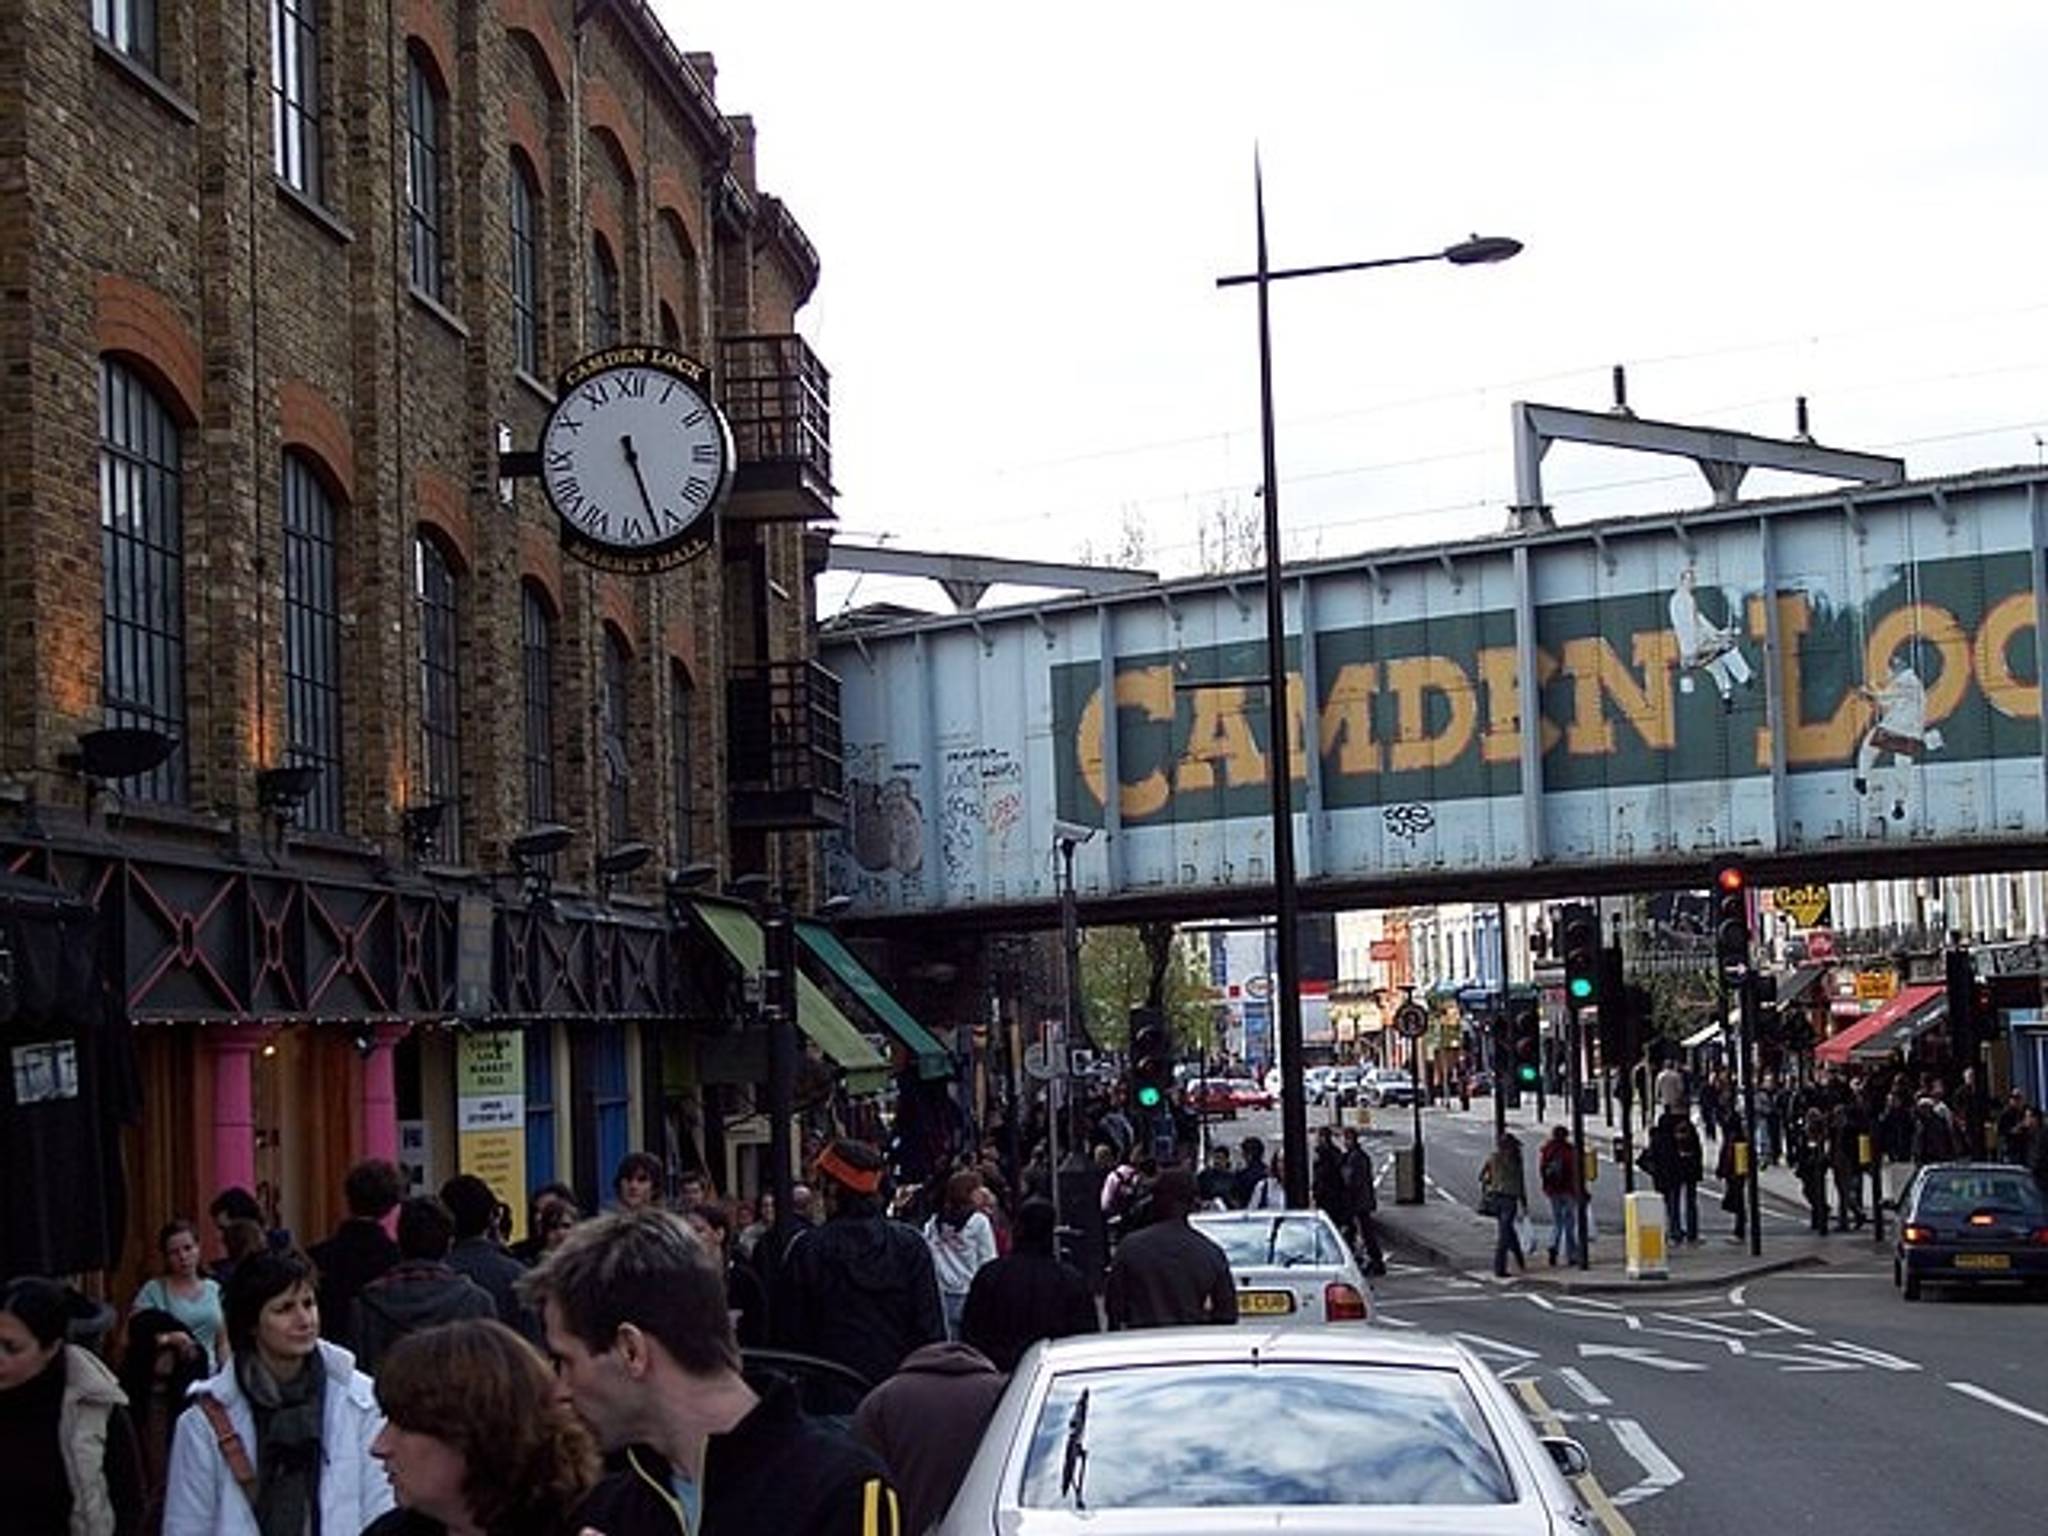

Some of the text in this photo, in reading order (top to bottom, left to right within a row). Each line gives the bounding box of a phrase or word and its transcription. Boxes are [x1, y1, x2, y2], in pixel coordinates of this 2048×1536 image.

[565, 348, 704, 385] CAMDEN LOCK
[582, 382, 610, 411] XI
[614, 371, 648, 399] XII
[556, 412, 583, 436] X
[682, 408, 707, 430] II
[691, 443, 719, 464] III
[655, 539, 708, 569] HALL
[1075, 628, 1683, 819] CAMDEN
[1775, 884, 1830, 905] Gold
